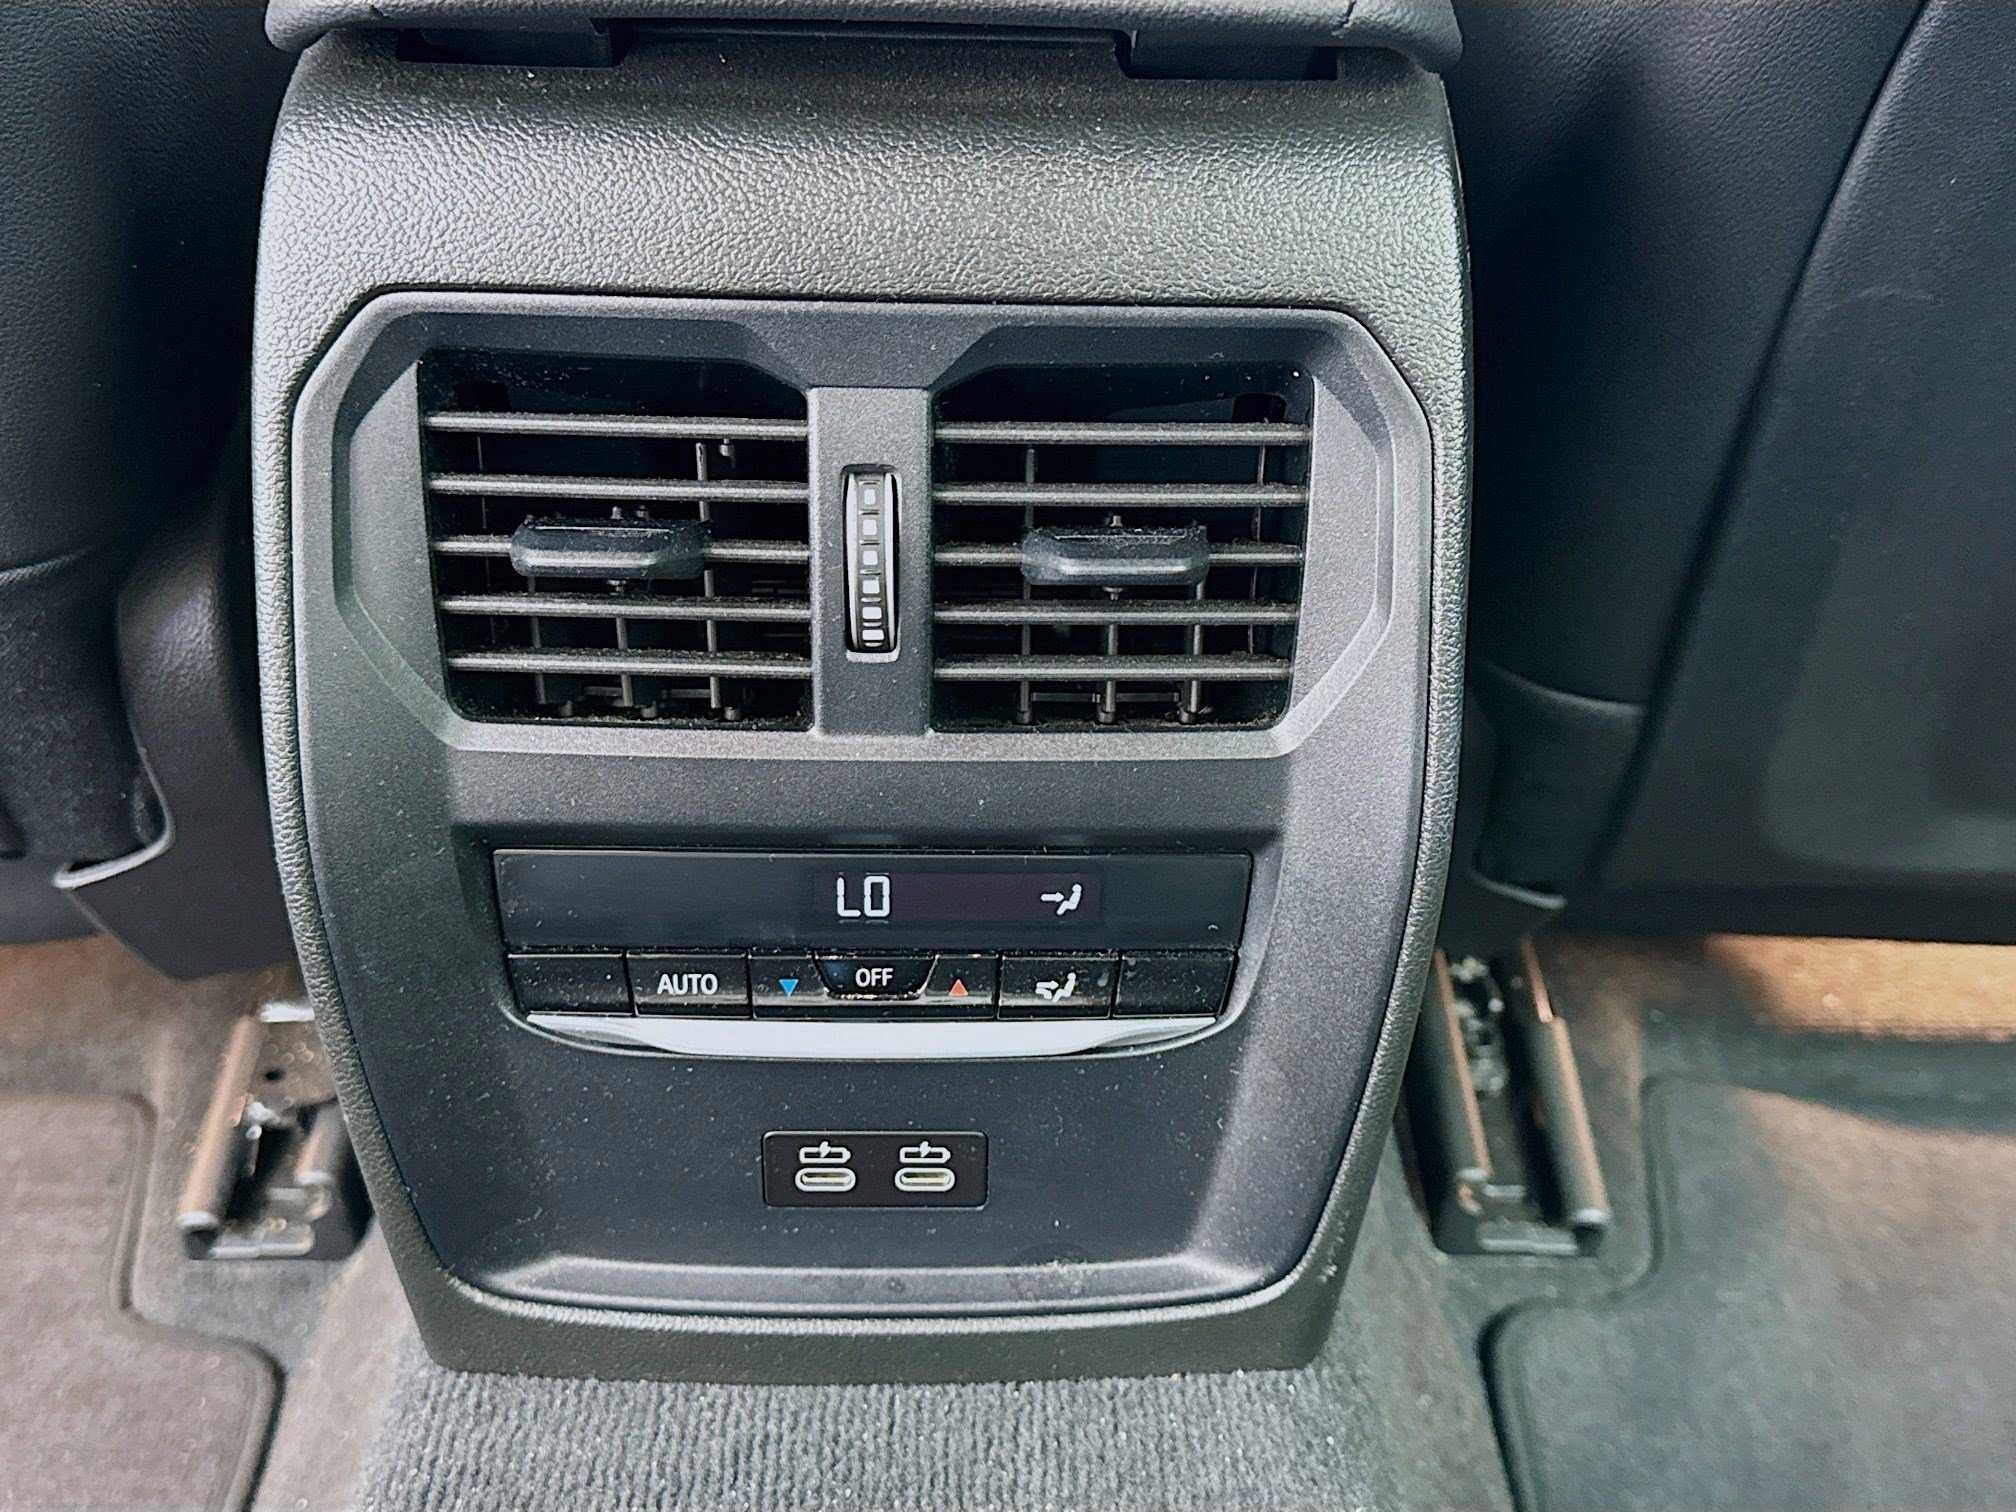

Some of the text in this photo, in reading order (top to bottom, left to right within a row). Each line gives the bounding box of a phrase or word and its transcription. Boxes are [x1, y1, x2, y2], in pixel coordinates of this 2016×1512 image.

[836, 875, 892, 919] LO
[656, 972, 719, 996] AUTO
[855, 967, 894, 988] OFF
